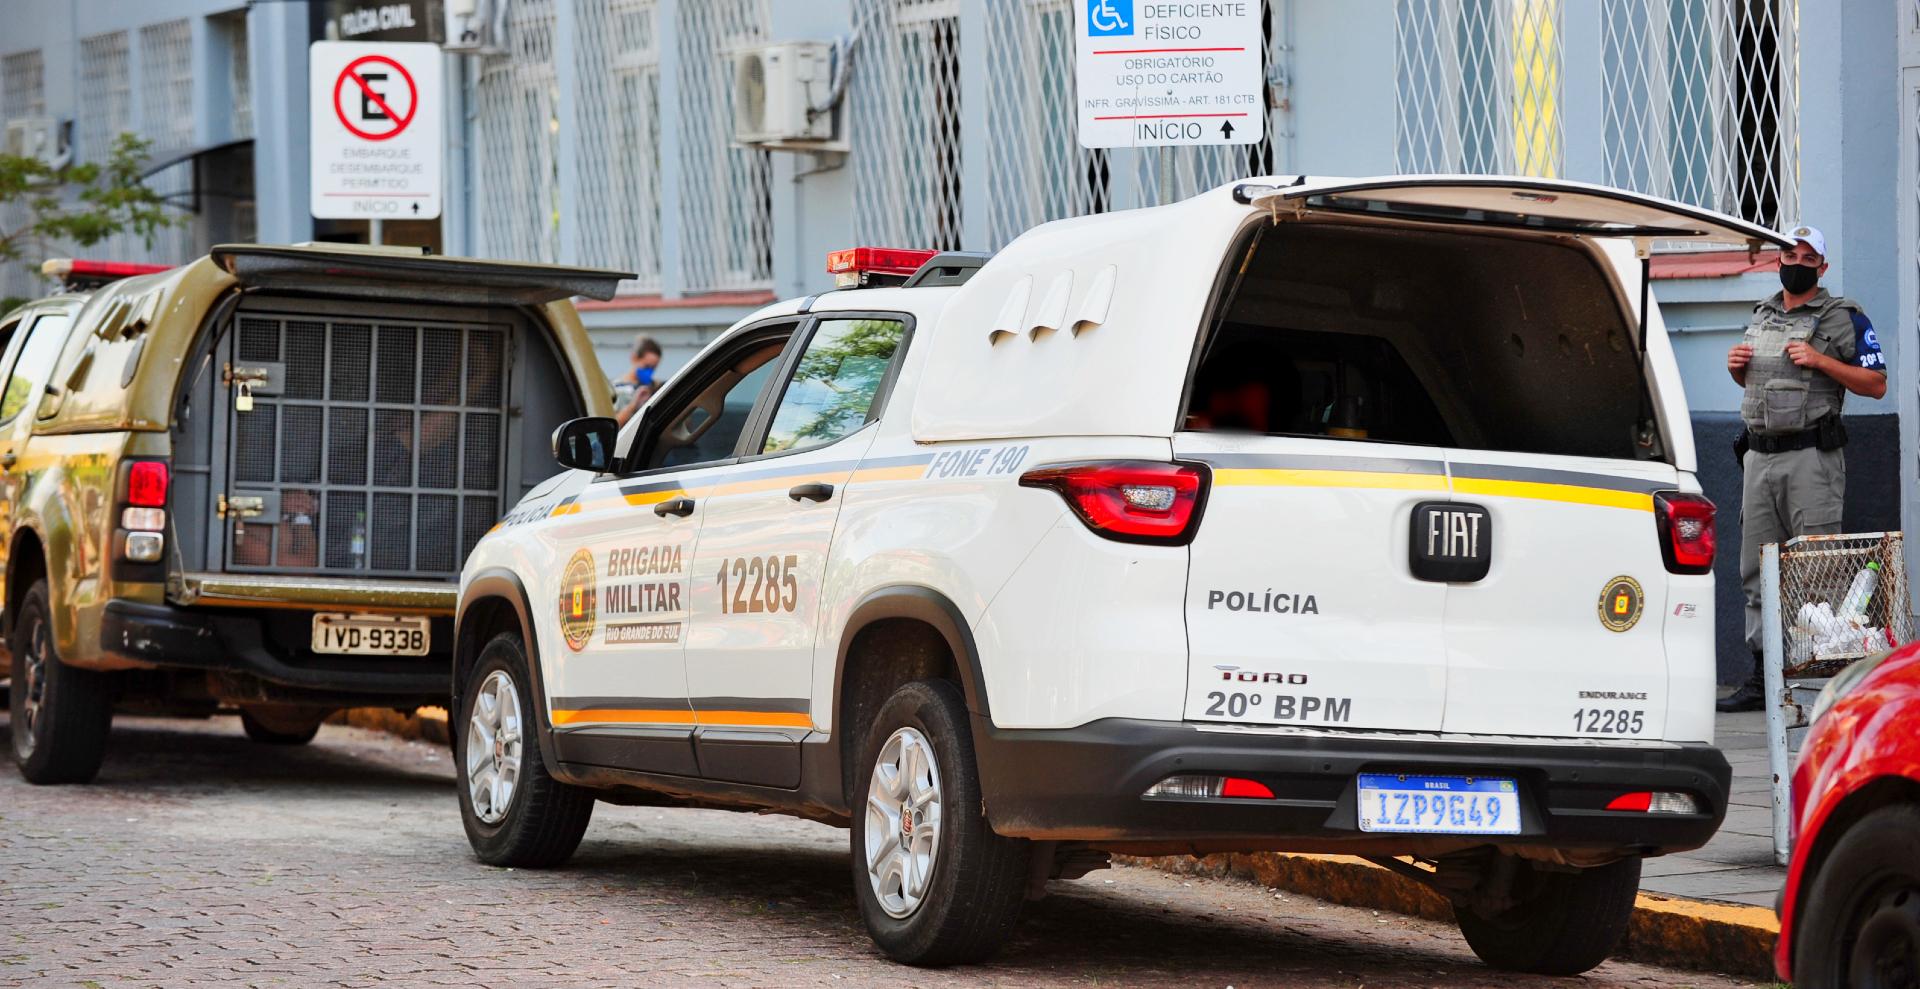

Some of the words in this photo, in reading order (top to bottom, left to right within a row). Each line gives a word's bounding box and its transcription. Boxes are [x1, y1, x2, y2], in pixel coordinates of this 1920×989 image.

[1144, 3, 1246, 19] DEFICIENTE
[1145, 23, 1201, 40] FÍSICO
[1124, 55, 1214, 70] OBRIGATÓRIO
[1116, 75, 1144, 86] USO
[1147, 74, 1167, 85] DO
[1170, 70, 1224, 84] CARTÃO
[1215, 95, 1230, 105] 181
[1233, 94, 1255, 105] CTB
[1138, 120, 1202, 140] INÍCIO
[926, 448, 991, 478] FONE
[987, 445, 1030, 475] 190
[1428, 510, 1483, 558] FIAT
[607, 545, 682, 576] BRIGADA
[716, 555, 798, 614] 12285
[605, 582, 681, 613] MILITAR
[1207, 588, 1319, 615] POLÍCIA
[606, 627, 620, 640] RIO
[620, 626, 652, 640] GRANDE
[651, 626, 663, 640] DO
[1213, 664, 1308, 685] TORO
[1578, 691, 1647, 700] ENDURANCE
[1205, 691, 1262, 718] 20º
[1273, 695, 1352, 722] BPM
[1573, 708, 1645, 734] 12285
[1424, 781, 1451, 790] BRASIL
[1376, 793, 1501, 826] IZP9G49
